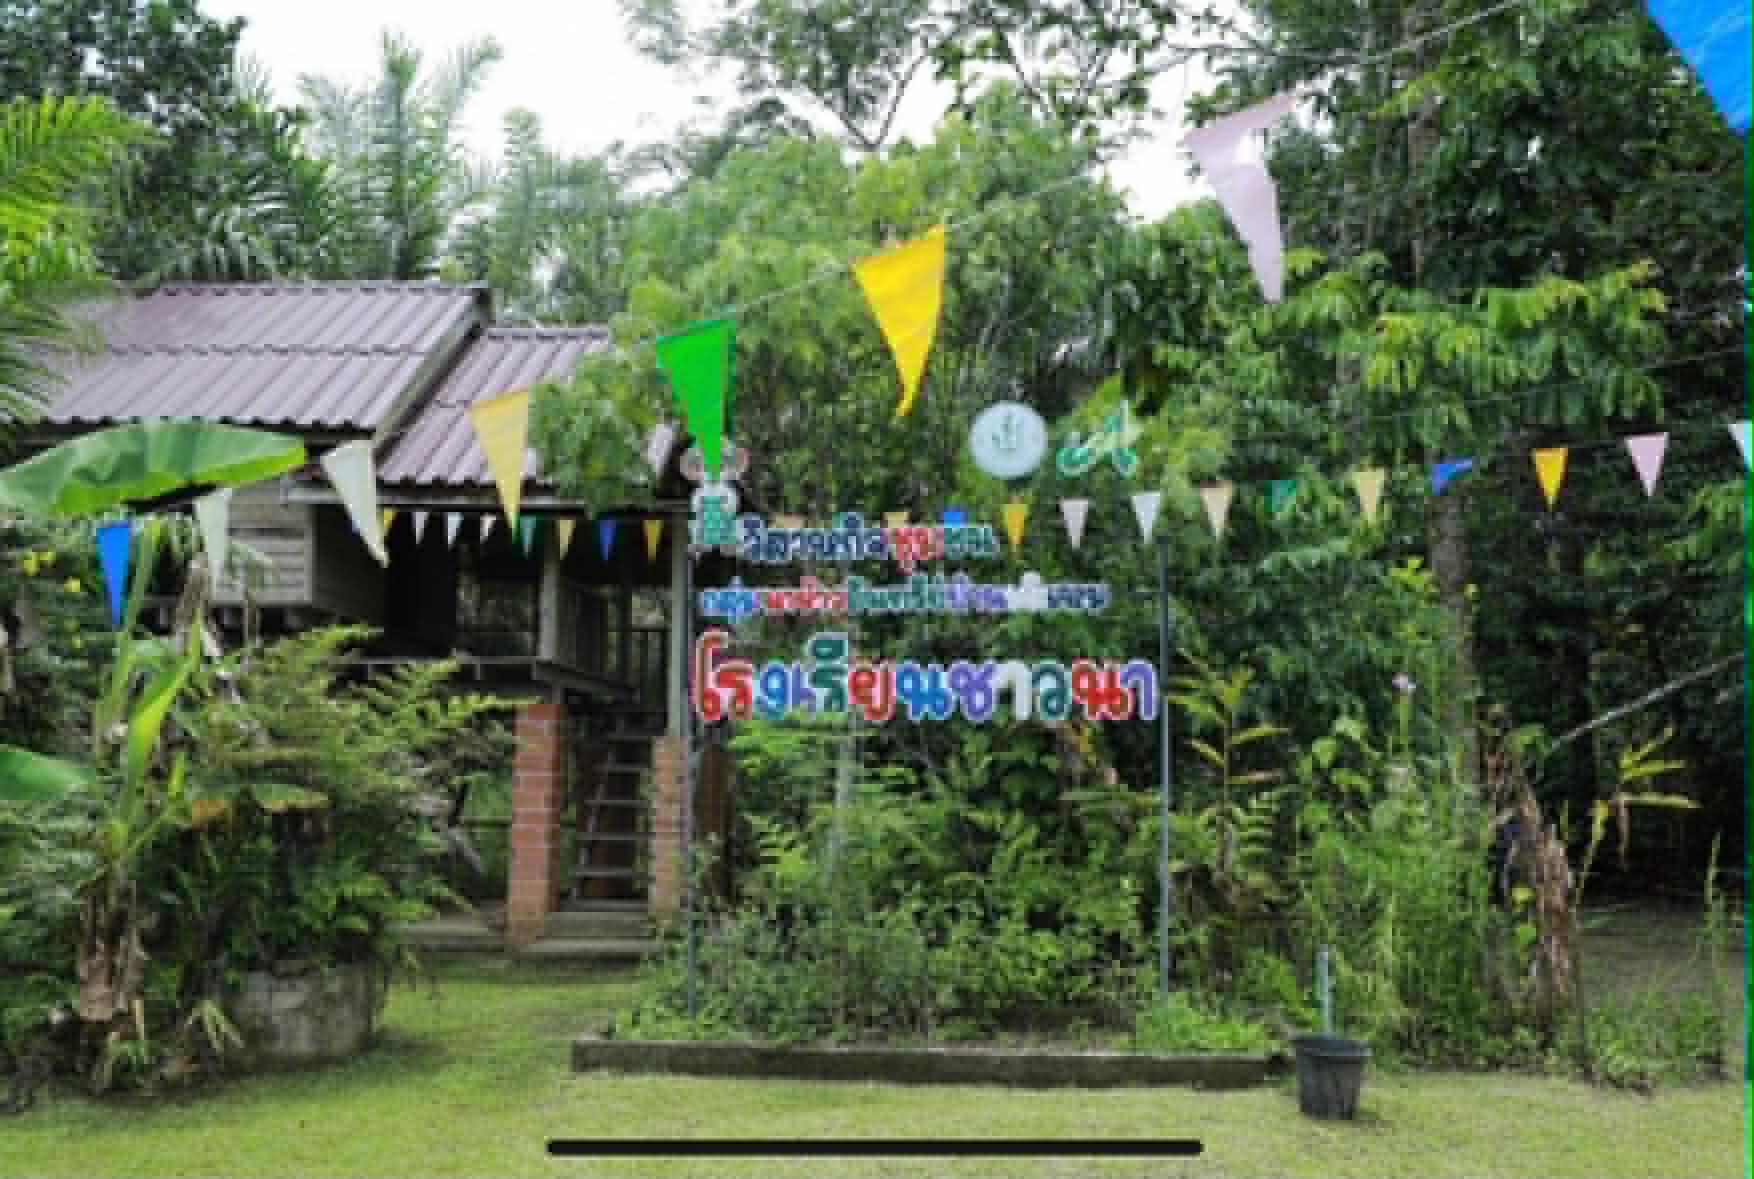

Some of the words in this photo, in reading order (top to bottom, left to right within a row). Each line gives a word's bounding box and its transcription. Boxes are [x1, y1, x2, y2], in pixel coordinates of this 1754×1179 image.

[693, 629, 1159, 720] โรงเรียนชาวนา
